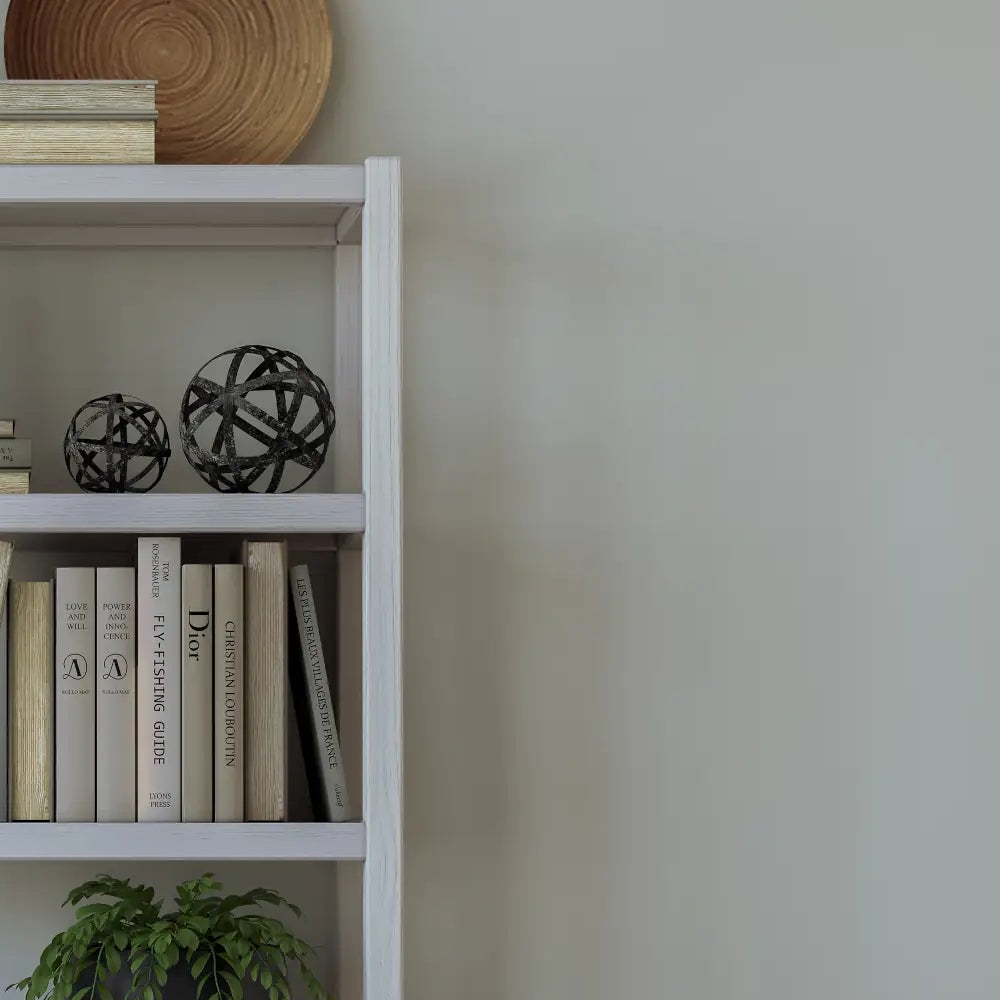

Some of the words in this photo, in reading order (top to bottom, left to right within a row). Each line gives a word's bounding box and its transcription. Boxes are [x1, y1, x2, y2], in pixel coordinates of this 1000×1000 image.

[151, 543, 160, 598] ROSENBAUER
[162, 562, 170, 582] TOM
[296, 579, 308, 597] LES
[301, 599, 312, 624] PLUS
[188, 608, 210, 662] Dior
[224, 620, 236, 688] CHRISTIAN
[304, 626, 319, 660] BEAUX
[153, 615, 165, 712] FLY-FISHING
[311, 661, 328, 710] VILLAGES
[224, 692, 236, 767] LOUBOUTIN
[319, 712, 331, 727] DE
[153, 721, 165, 765] GUIDE
[323, 728, 338, 769] FRANCE
